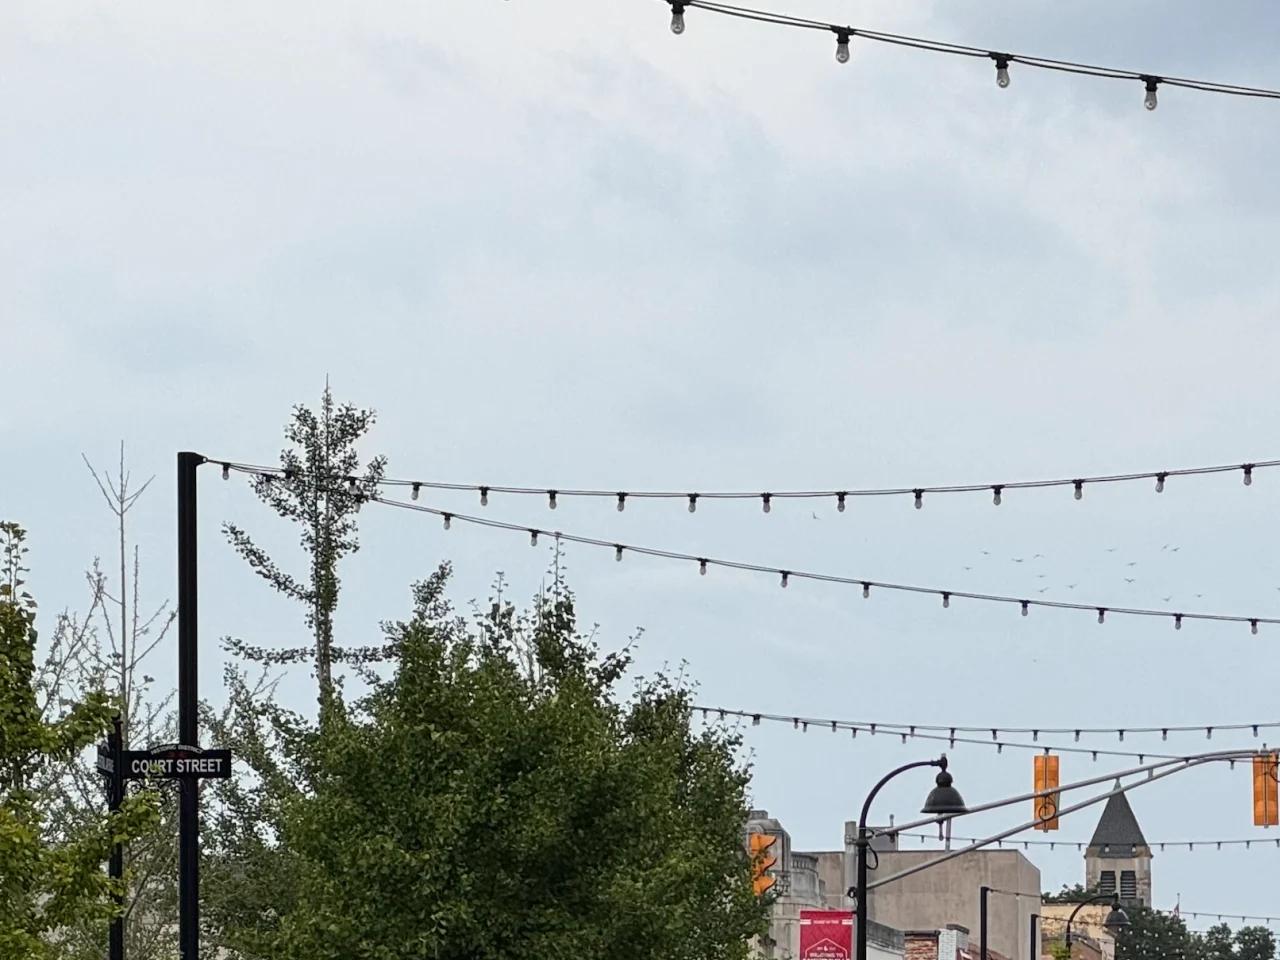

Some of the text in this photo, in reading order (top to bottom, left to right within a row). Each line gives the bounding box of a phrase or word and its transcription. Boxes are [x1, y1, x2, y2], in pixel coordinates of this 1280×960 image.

[178, 744, 204, 755] DISTRICT
[132, 759, 223, 774] COURT STREET
